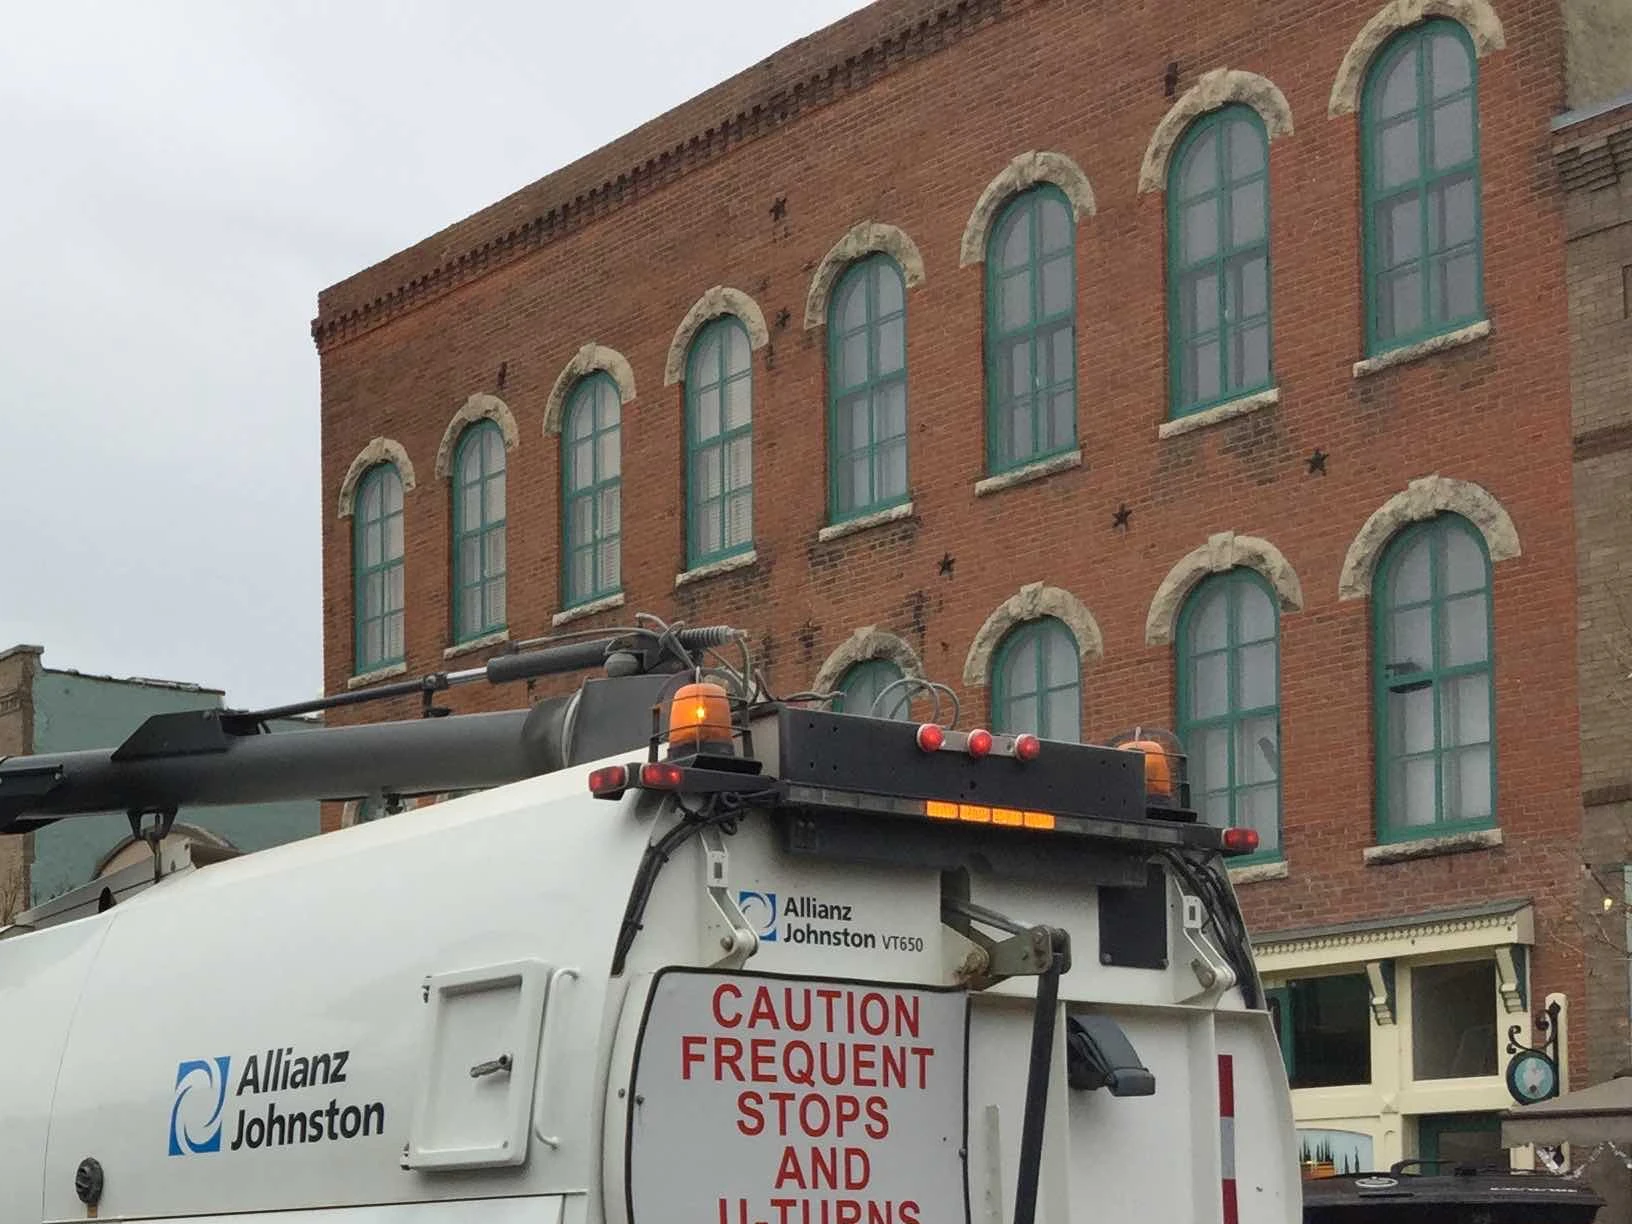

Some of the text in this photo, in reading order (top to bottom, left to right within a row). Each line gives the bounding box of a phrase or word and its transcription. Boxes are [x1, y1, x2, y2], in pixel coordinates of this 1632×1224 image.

[783, 896, 852, 921] Allianz
[783, 923, 924, 952] Johnston VT650
[712, 983, 920, 1038] CAUTION
[236, 1047, 350, 1096] Allianz
[681, 1036, 935, 1089] FREQUENT
[230, 1098, 385, 1151] Johnston
[736, 1090, 890, 1140] STOPS
[774, 1146, 871, 1190] AND
